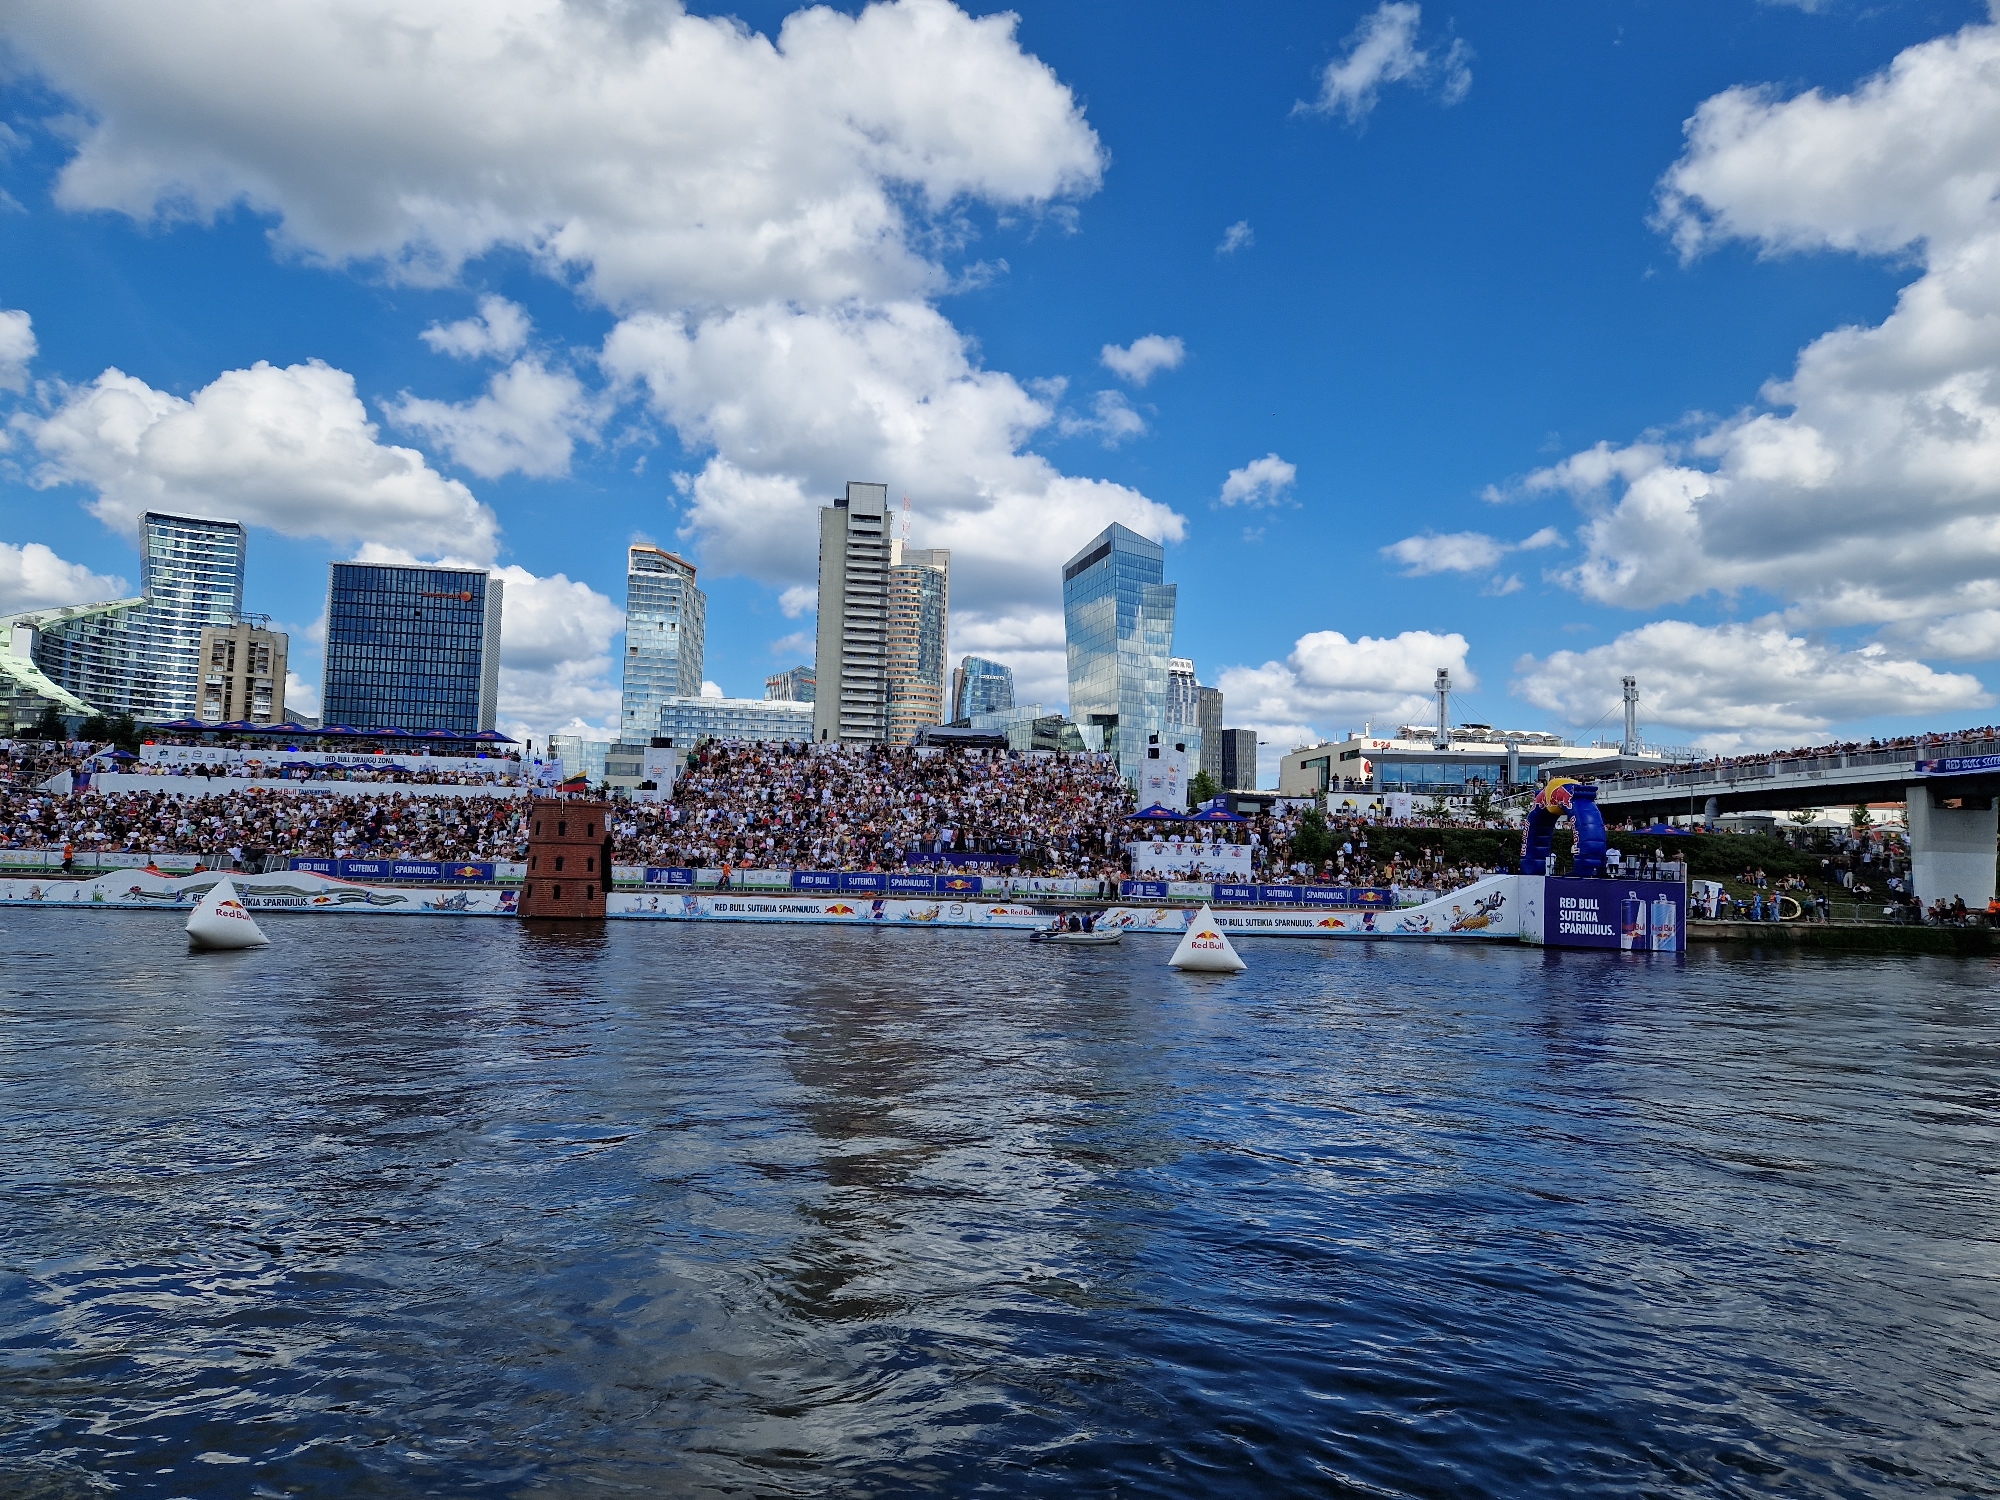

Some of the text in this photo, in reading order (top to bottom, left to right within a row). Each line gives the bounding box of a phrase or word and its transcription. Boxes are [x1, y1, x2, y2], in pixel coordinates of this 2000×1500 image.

[1945, 759, 1960, 770] RED
[1961, 758, 1981, 769] BULL
[299, 862, 330, 872] RED BULL
[348, 864, 379, 873] SUTEIKIA
[394, 865, 439, 875] SPARNUUUS.
[801, 875, 830, 885] RED BULL
[848, 877, 877, 886] SUTEIKIA
[891, 878, 931, 888] SPARNUUUS.
[1221, 888, 1250, 898] RED BULL
[1266, 889, 1293, 898] SUTEIKIA
[1306, 891, 1345, 900] SPARNUUUS.
[263, 897, 310, 907] SPARNUUUS.
[1559, 896, 1600, 911] RED BULL
[215, 908, 236, 918] Red
[714, 903, 822, 914] RED BULL SUTEIKIA SPARNUUUS.
[1559, 910, 1599, 923] SUTEIKIA
[1229, 918, 1244, 927] BULL
[1245, 918, 1273, 927] SUTEIKIA
[1275, 919, 1315, 928] SPARNUUUS.
[1559, 922, 1616, 936] SPARNUUUS.
[1191, 941, 1225, 950] Red Bull
